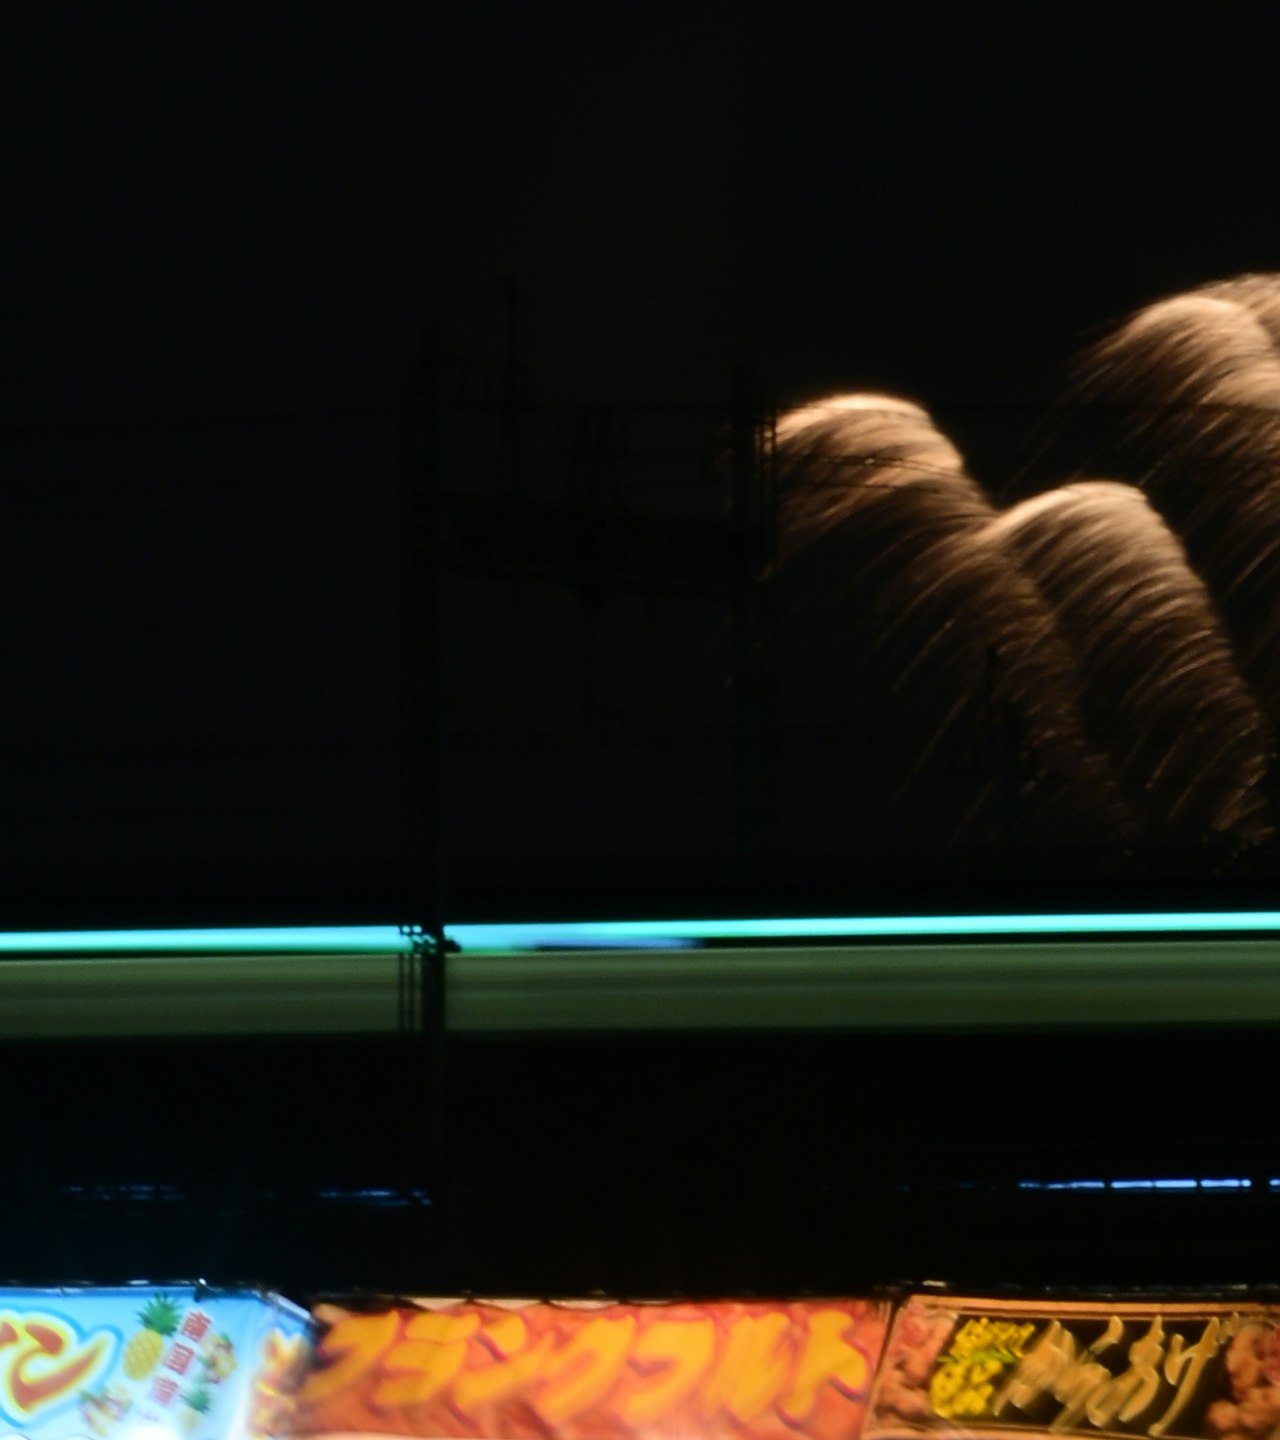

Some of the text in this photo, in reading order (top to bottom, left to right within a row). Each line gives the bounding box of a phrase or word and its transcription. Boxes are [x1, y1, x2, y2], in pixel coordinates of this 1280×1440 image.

[303, 1308, 870, 1424] フランクフルト
